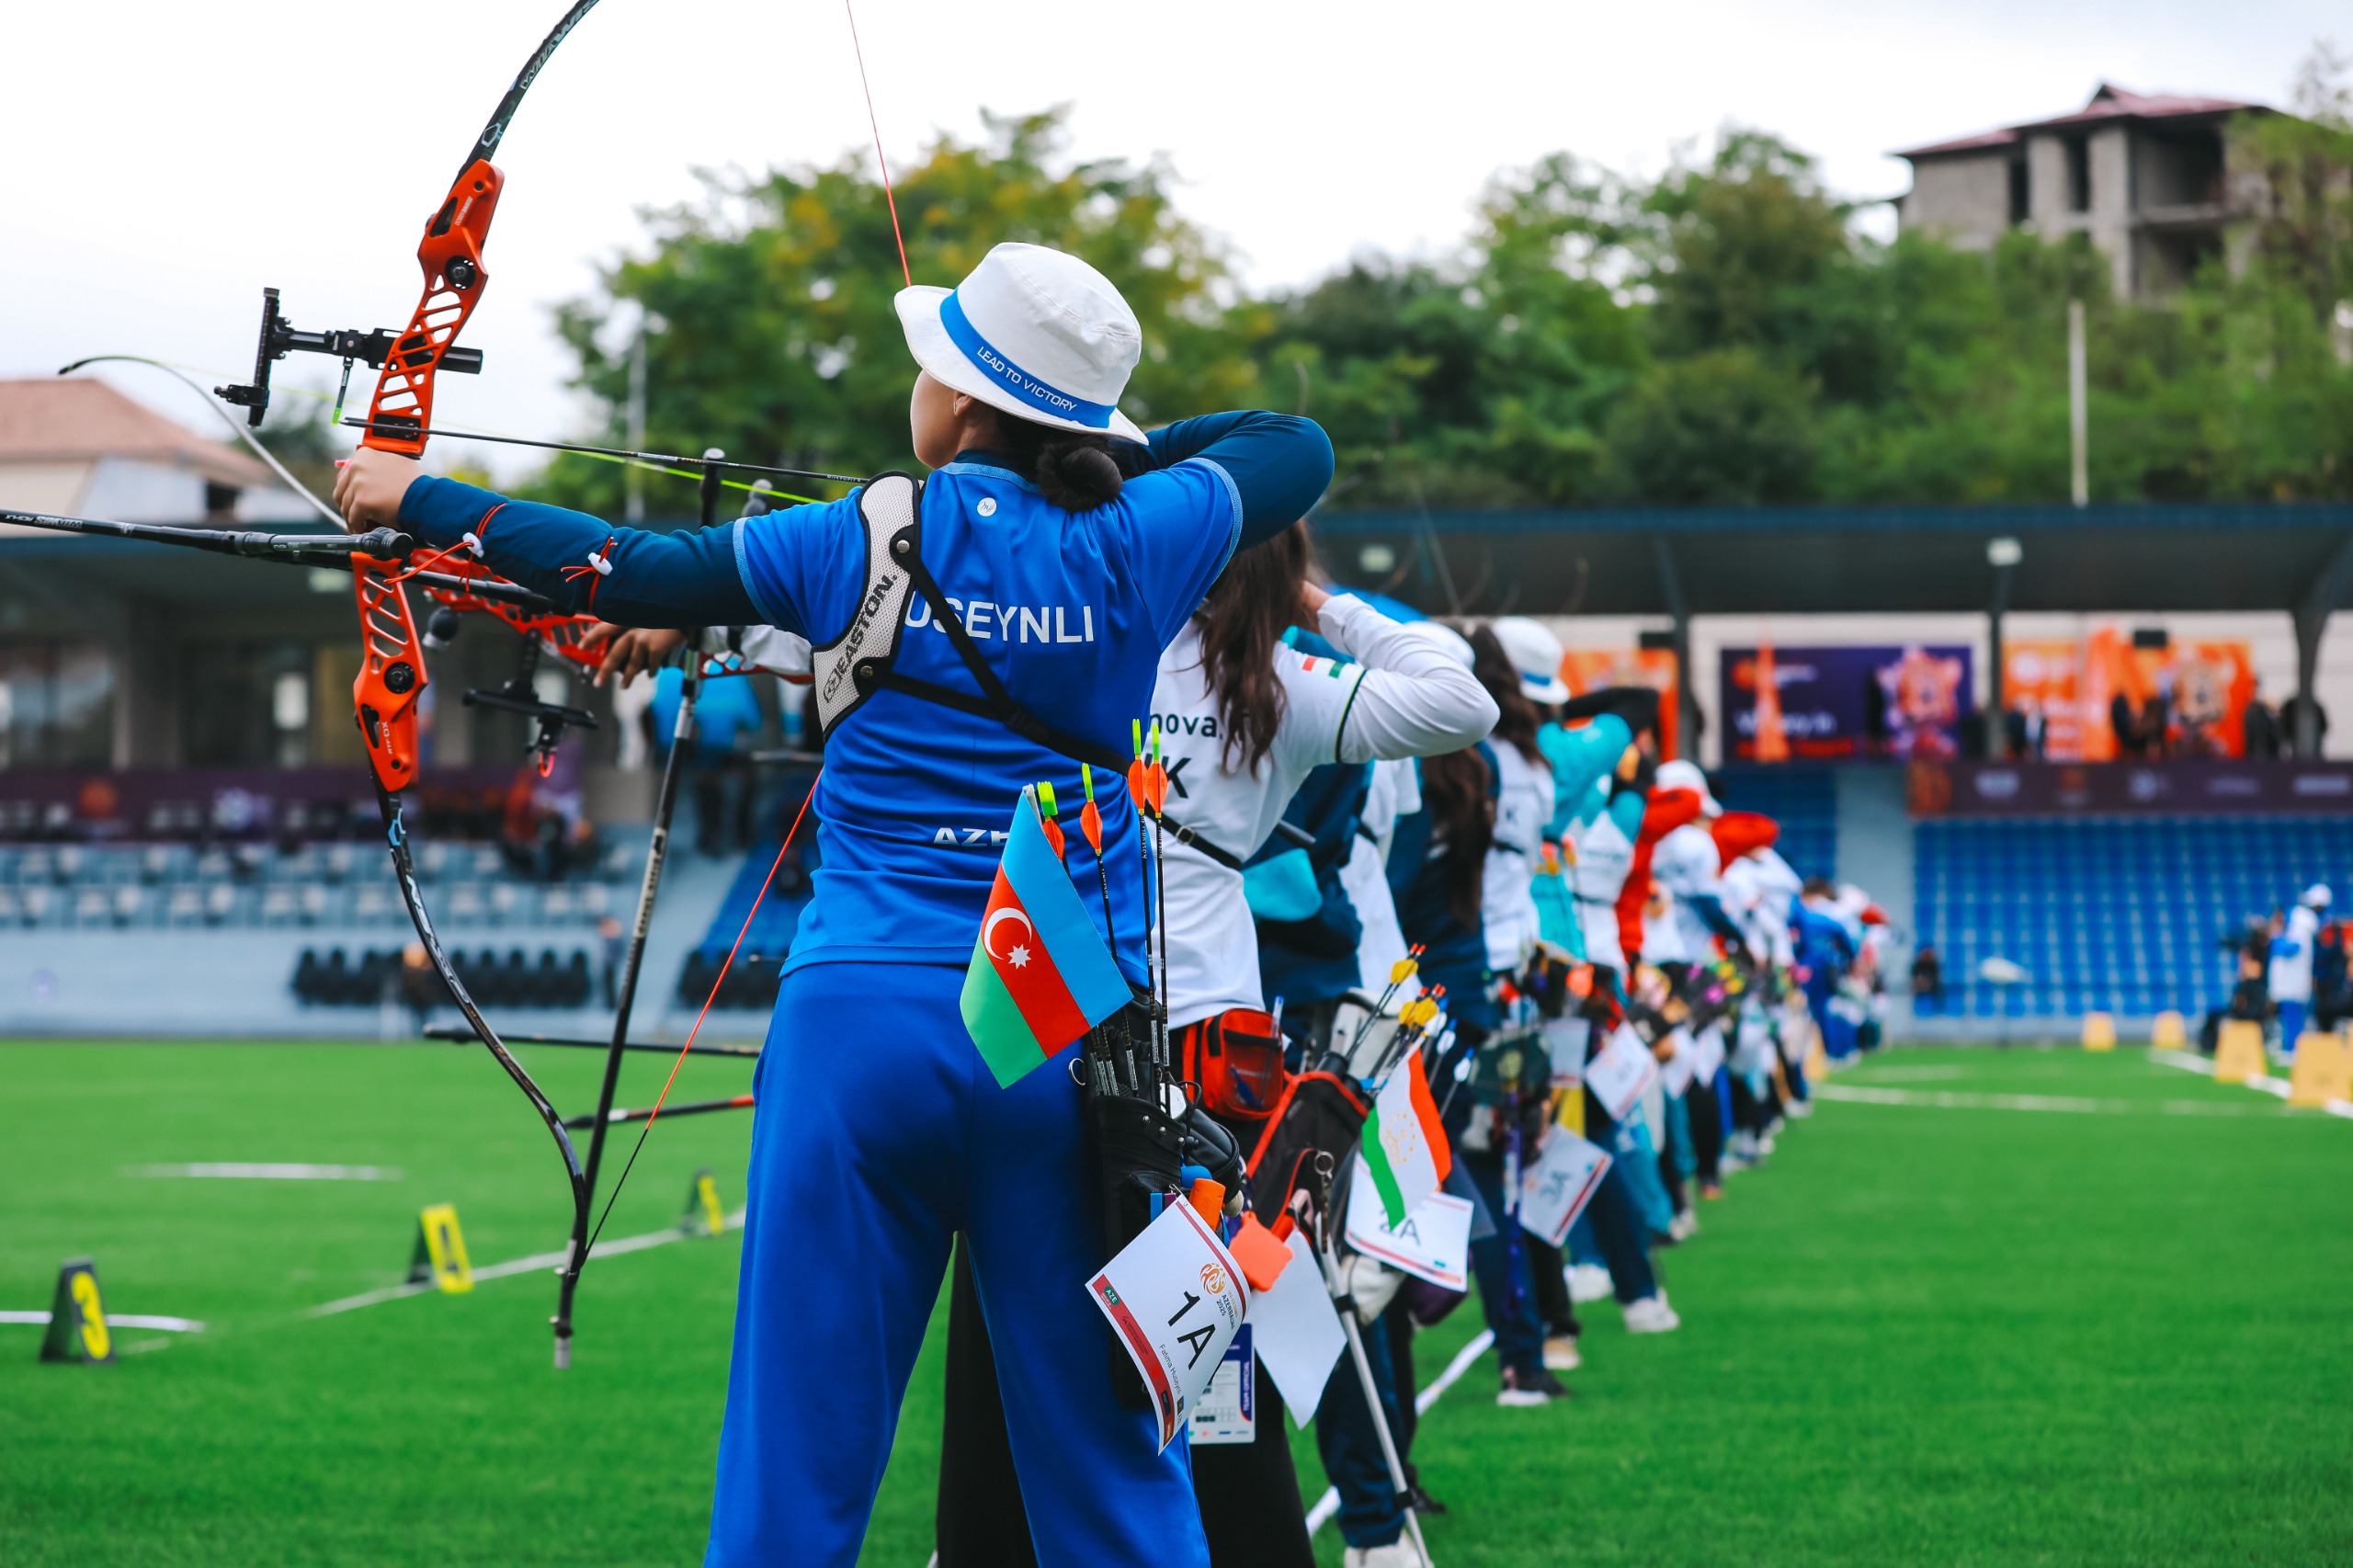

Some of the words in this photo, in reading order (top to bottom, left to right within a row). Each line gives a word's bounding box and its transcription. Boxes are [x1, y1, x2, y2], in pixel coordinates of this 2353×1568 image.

[977, 346, 1005, 372] LEAD
[1006, 367, 1022, 384] TO
[1024, 379, 1077, 412] VICTORY
[835, 574, 894, 675] EASTON
[904, 590, 1094, 643] USEYNLI
[71, 1271, 110, 1360] 3
[1167, 1290, 1216, 1370] 1A
[1216, 1299, 1227, 1317] 2025
[1222, 1294, 1235, 1331] AZERBAIJAN
[1159, 1344, 1173, 1369] Fatima
